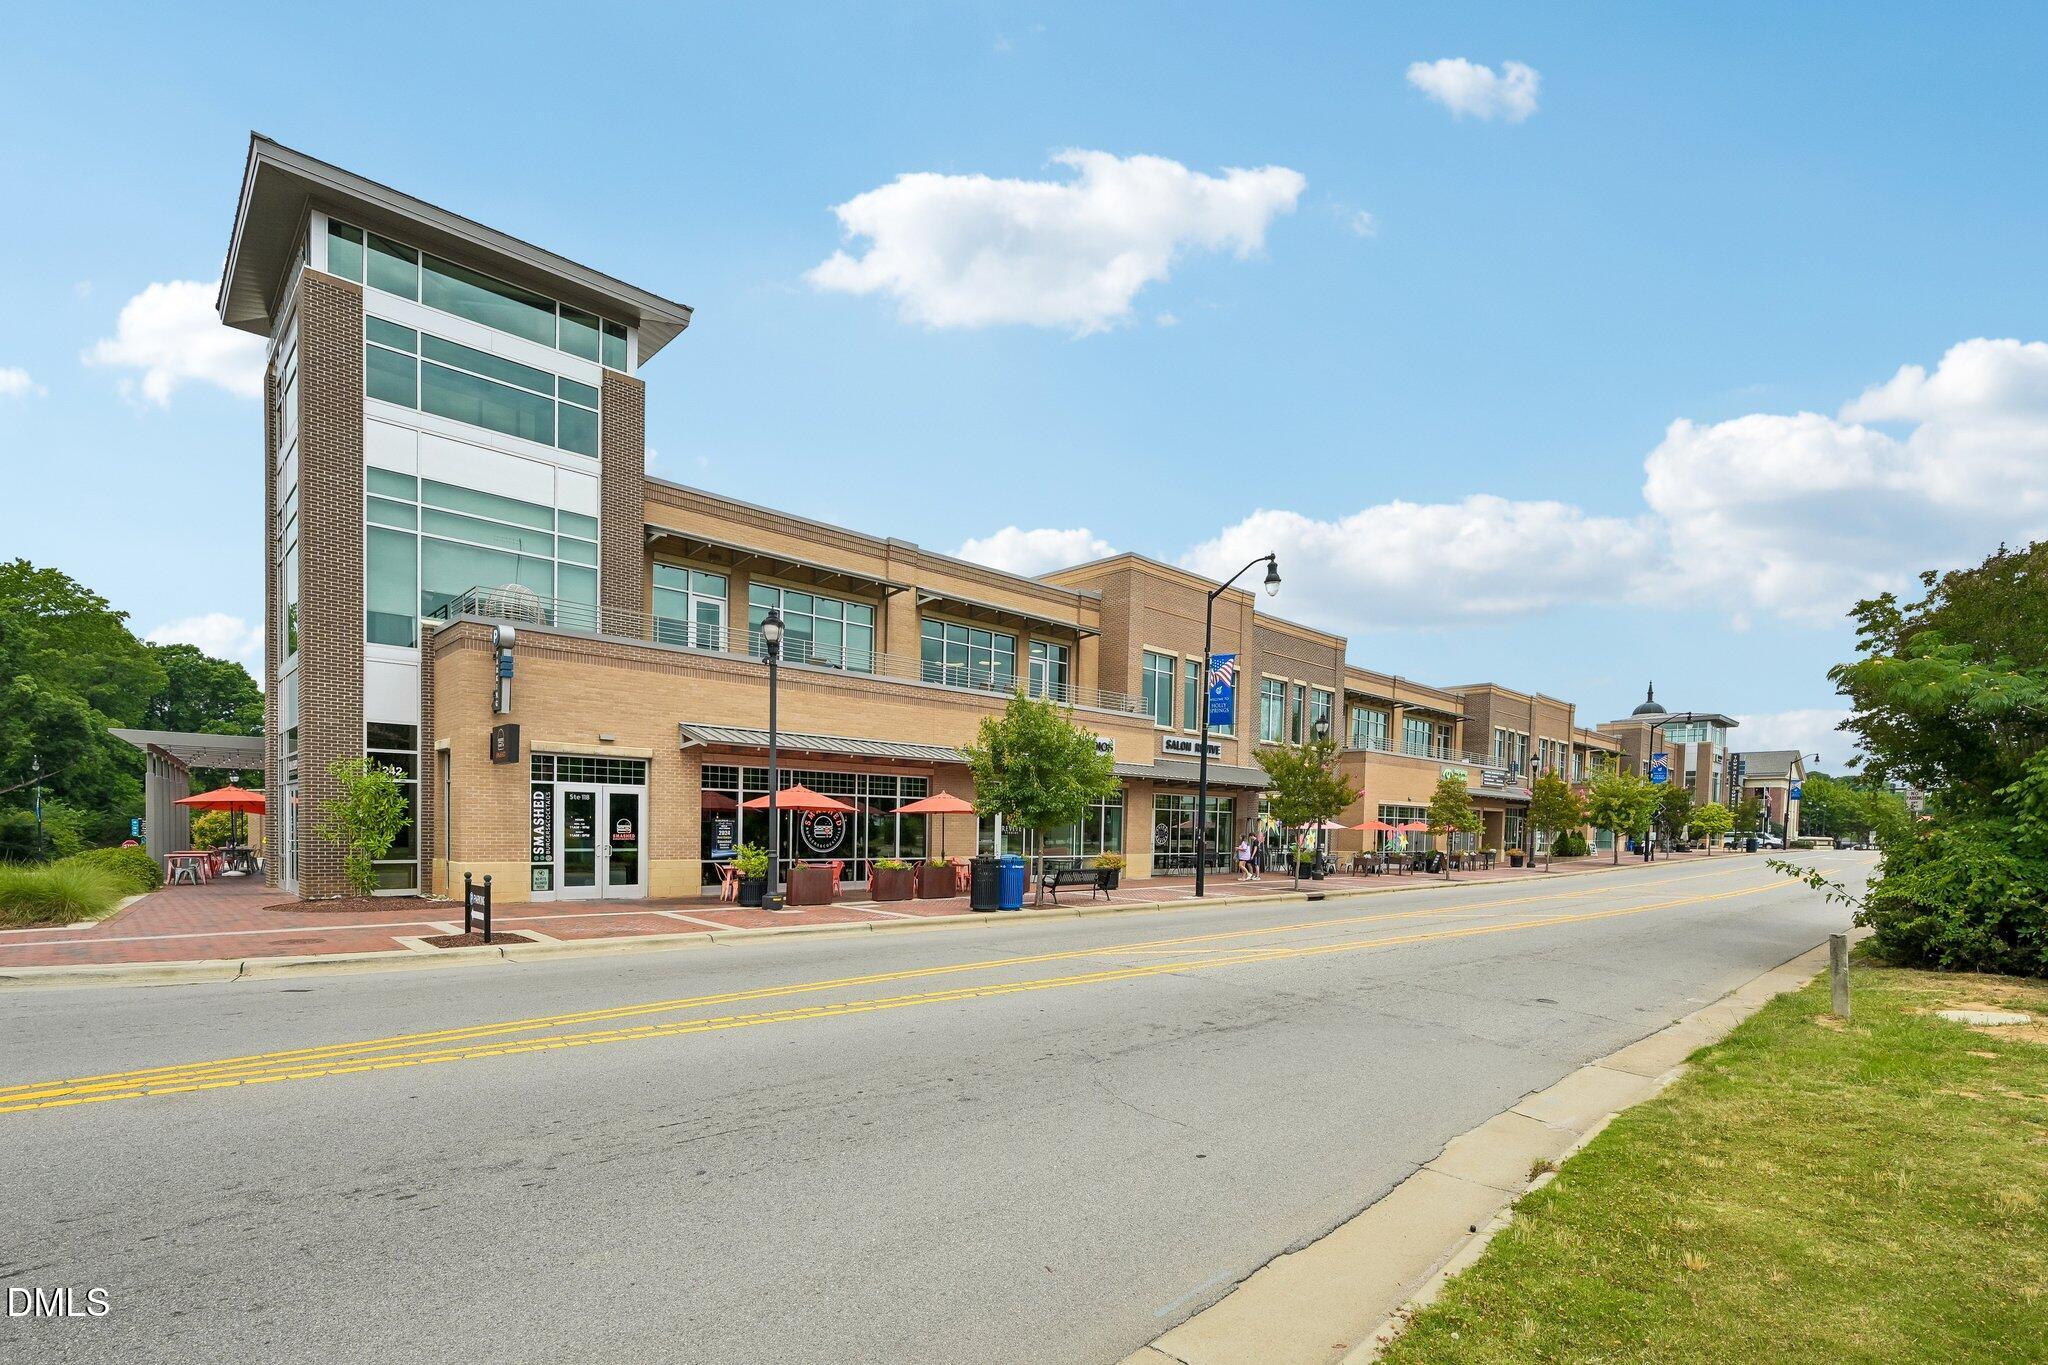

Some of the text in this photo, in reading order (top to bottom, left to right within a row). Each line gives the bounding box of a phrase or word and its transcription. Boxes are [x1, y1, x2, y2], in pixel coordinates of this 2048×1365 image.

[1165, 739, 1221, 756] SALON REIVE
[569, 793, 581, 801] Ste
[533, 791, 545, 855] SMASHED
[804, 810, 842, 826] SMHED
